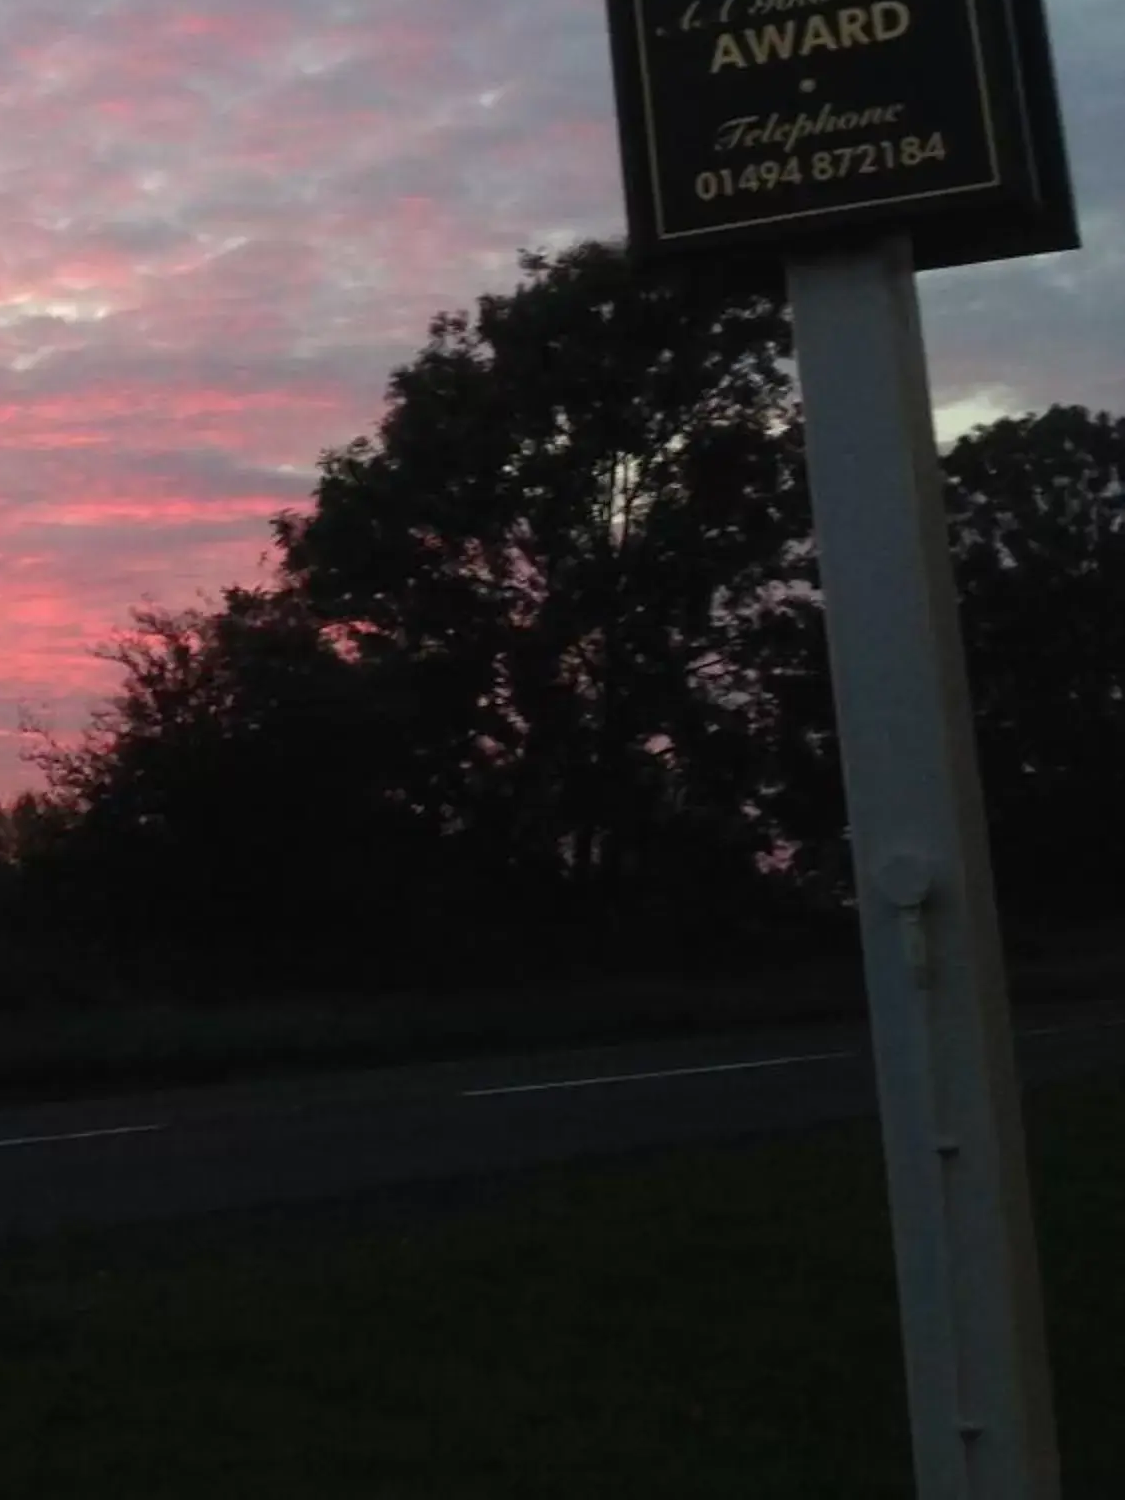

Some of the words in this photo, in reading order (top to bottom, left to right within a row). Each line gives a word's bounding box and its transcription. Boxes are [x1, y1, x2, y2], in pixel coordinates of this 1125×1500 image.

[709, 0, 911, 74] AWARD
[713, 102, 905, 153] Telephone
[694, 156, 805, 201] 01494
[811, 131, 946, 182] 872184
